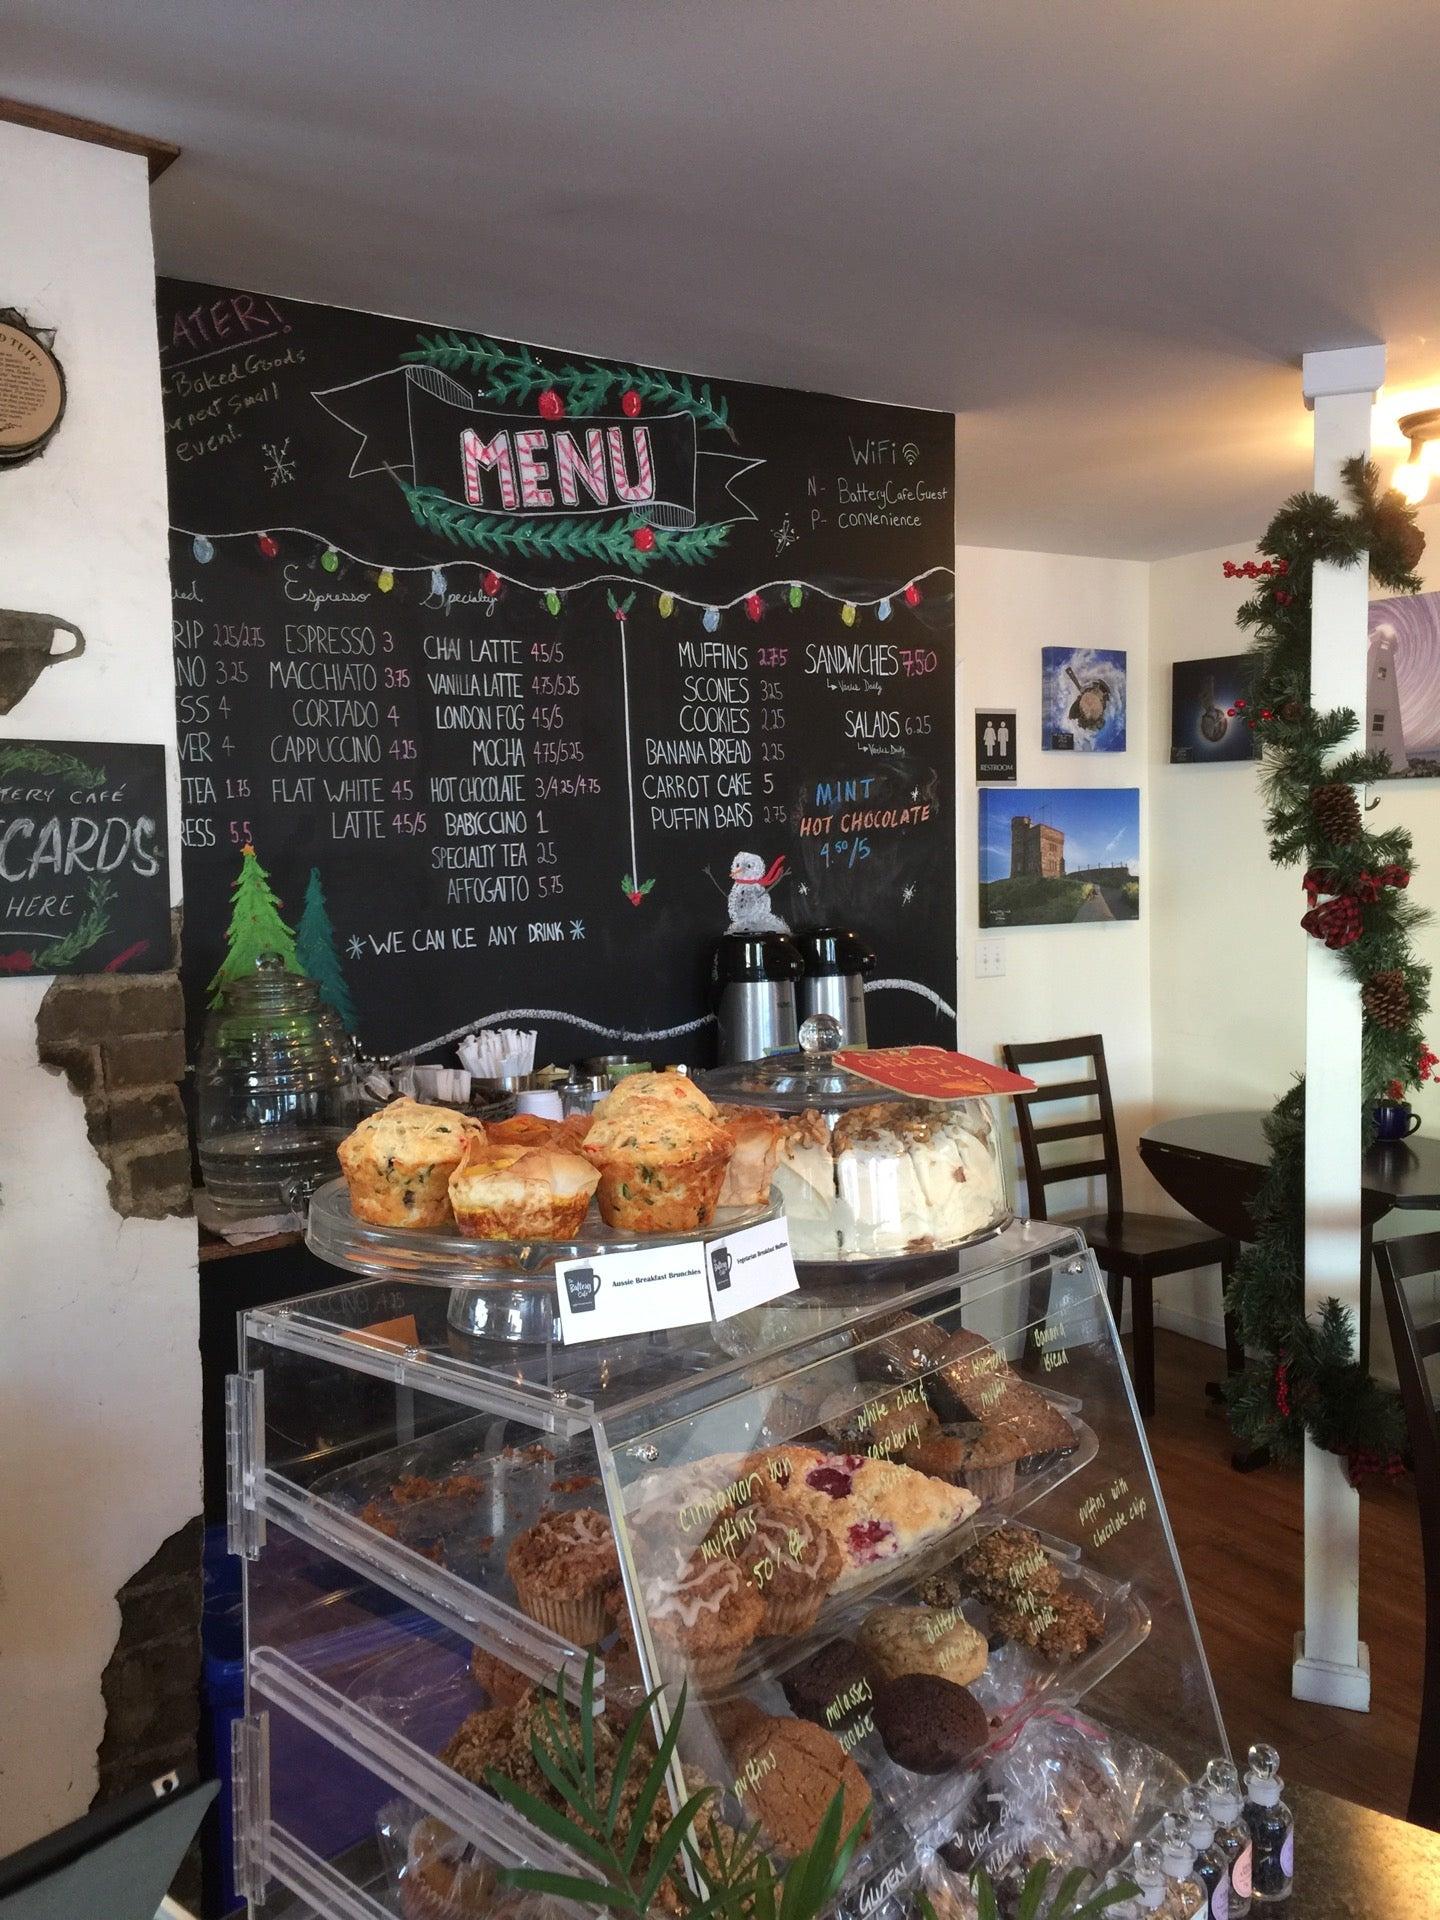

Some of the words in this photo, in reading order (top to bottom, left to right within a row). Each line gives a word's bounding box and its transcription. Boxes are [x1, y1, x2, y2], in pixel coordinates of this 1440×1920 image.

[849, 435, 896, 466] WiFi
[460, 427, 656, 510] MENU
[837, 477, 948, 510] BatteryCafeGuest
[283, 564, 371, 611] Espresso
[419, 588, 498, 617] Specialty
[285, 625, 375, 656] ESPRESSO
[382, 631, 394, 652] 3
[424, 636, 460, 661] CHAI
[470, 639, 522, 664] LATTE
[678, 641, 748, 670] MUFFINS
[805, 644, 899, 676] SANDWICHES
[899, 649, 937, 677] 7.50
[174, 656, 206, 687] NO
[270, 661, 377, 691] MACCHIATO
[427, 673, 481, 696] VANILLA
[484, 673, 523, 698] LATTE
[683, 676, 749, 703] SCONES
[218, 696, 231, 719] 4
[293, 699, 378, 727] CORTADO
[387, 705, 400, 727] 4
[436, 705, 491, 730] LONDON
[496, 704, 525, 731] FOG
[680, 705, 750, 734] COOKIES
[845, 710, 900, 738] SALADS
[222, 736, 235, 757] 4
[271, 734, 381, 763] CAPPUCCINO
[473, 738, 525, 767] MOCHA
[646, 738, 707, 765] BANANA
[709, 738, 751, 764] BREAD
[182, 777, 216, 803] TEA
[272, 778, 315, 802] FLAT
[324, 778, 385, 802] WHITE
[431, 777, 457, 802] HOT
[459, 775, 525, 802] CHOCOLATE
[643, 775, 709, 799] CARROT
[718, 773, 752, 797] CAKE
[763, 773, 774, 794] 5
[816, 778, 875, 806] MINT
[332, 811, 385, 839] LATTE
[445, 811, 527, 836] BABYCCINO
[537, 810, 549, 834] 1
[651, 807, 709, 830] PUFFIN
[714, 803, 752, 828] BARS
[800, 815, 833, 837] HOT
[841, 805, 931, 833] CHOCOLATE
[0, 814, 159, 882] CARDS
[432, 843, 496, 869] SPECIALTY
[501, 843, 528, 867] TEA
[448, 876, 529, 904] AFFOGATTO
[6, 896, 74, 918] HERE
[369, 931, 406, 955] WE
[413, 930, 444, 951] CAN
[452, 928, 477, 949] ICE
[489, 926, 517, 946] ANY
[528, 922, 565, 943] DRINK
[612, 1279, 634, 1287] Aussie
[635, 1275, 667, 1284] Breakfast
[668, 1269, 701, 1278] Brunchies
[868, 1422, 920, 1463] raspberry
[680, 1472, 763, 1532] cinnamon
[701, 1510, 757, 1564] muffins
[1093, 1512, 1127, 1547] chocolate
[826, 1677, 872, 1727] molasses
[839, 1707, 874, 1755] cookie
[860, 1862, 907, 1915] GLUTEN
